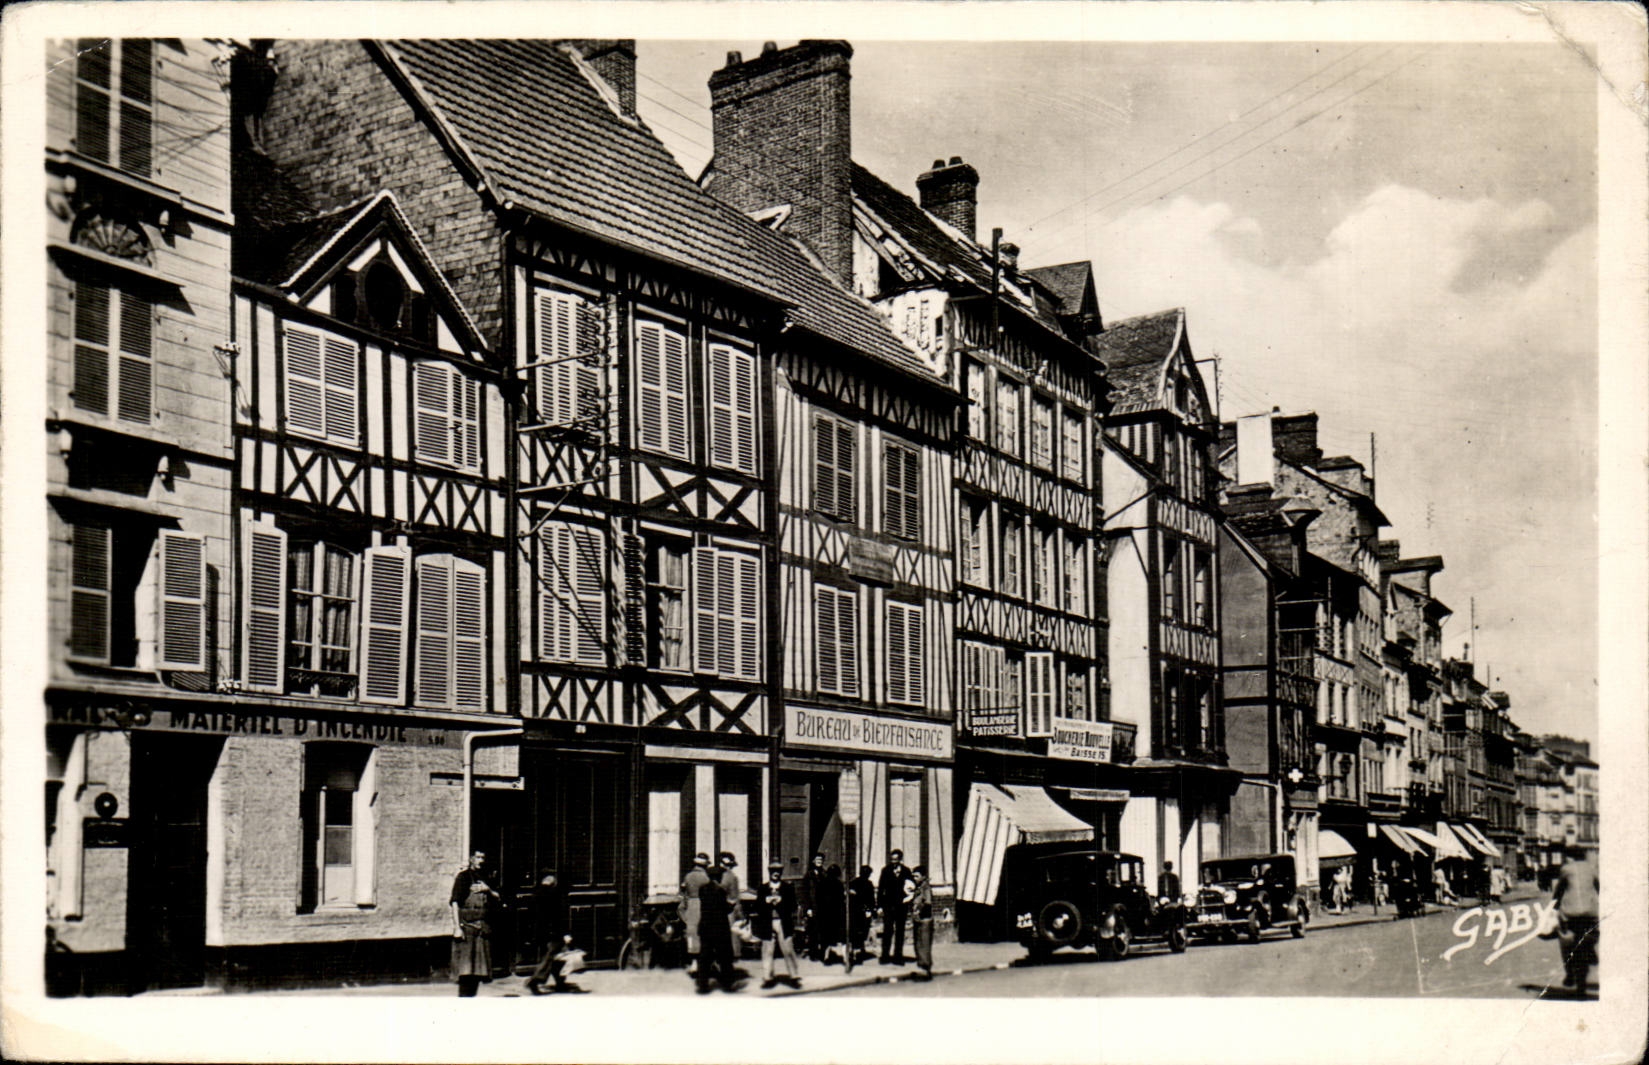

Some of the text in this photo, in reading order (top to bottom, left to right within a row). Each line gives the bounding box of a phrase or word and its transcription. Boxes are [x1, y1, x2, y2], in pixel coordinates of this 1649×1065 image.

[972, 715, 1017, 726] BOULANGERIE
[796, 711, 851, 741] BUREAU
[862, 718, 943, 751] BIENFAISANCE
[973, 725, 1017, 736] PATISSERIE
